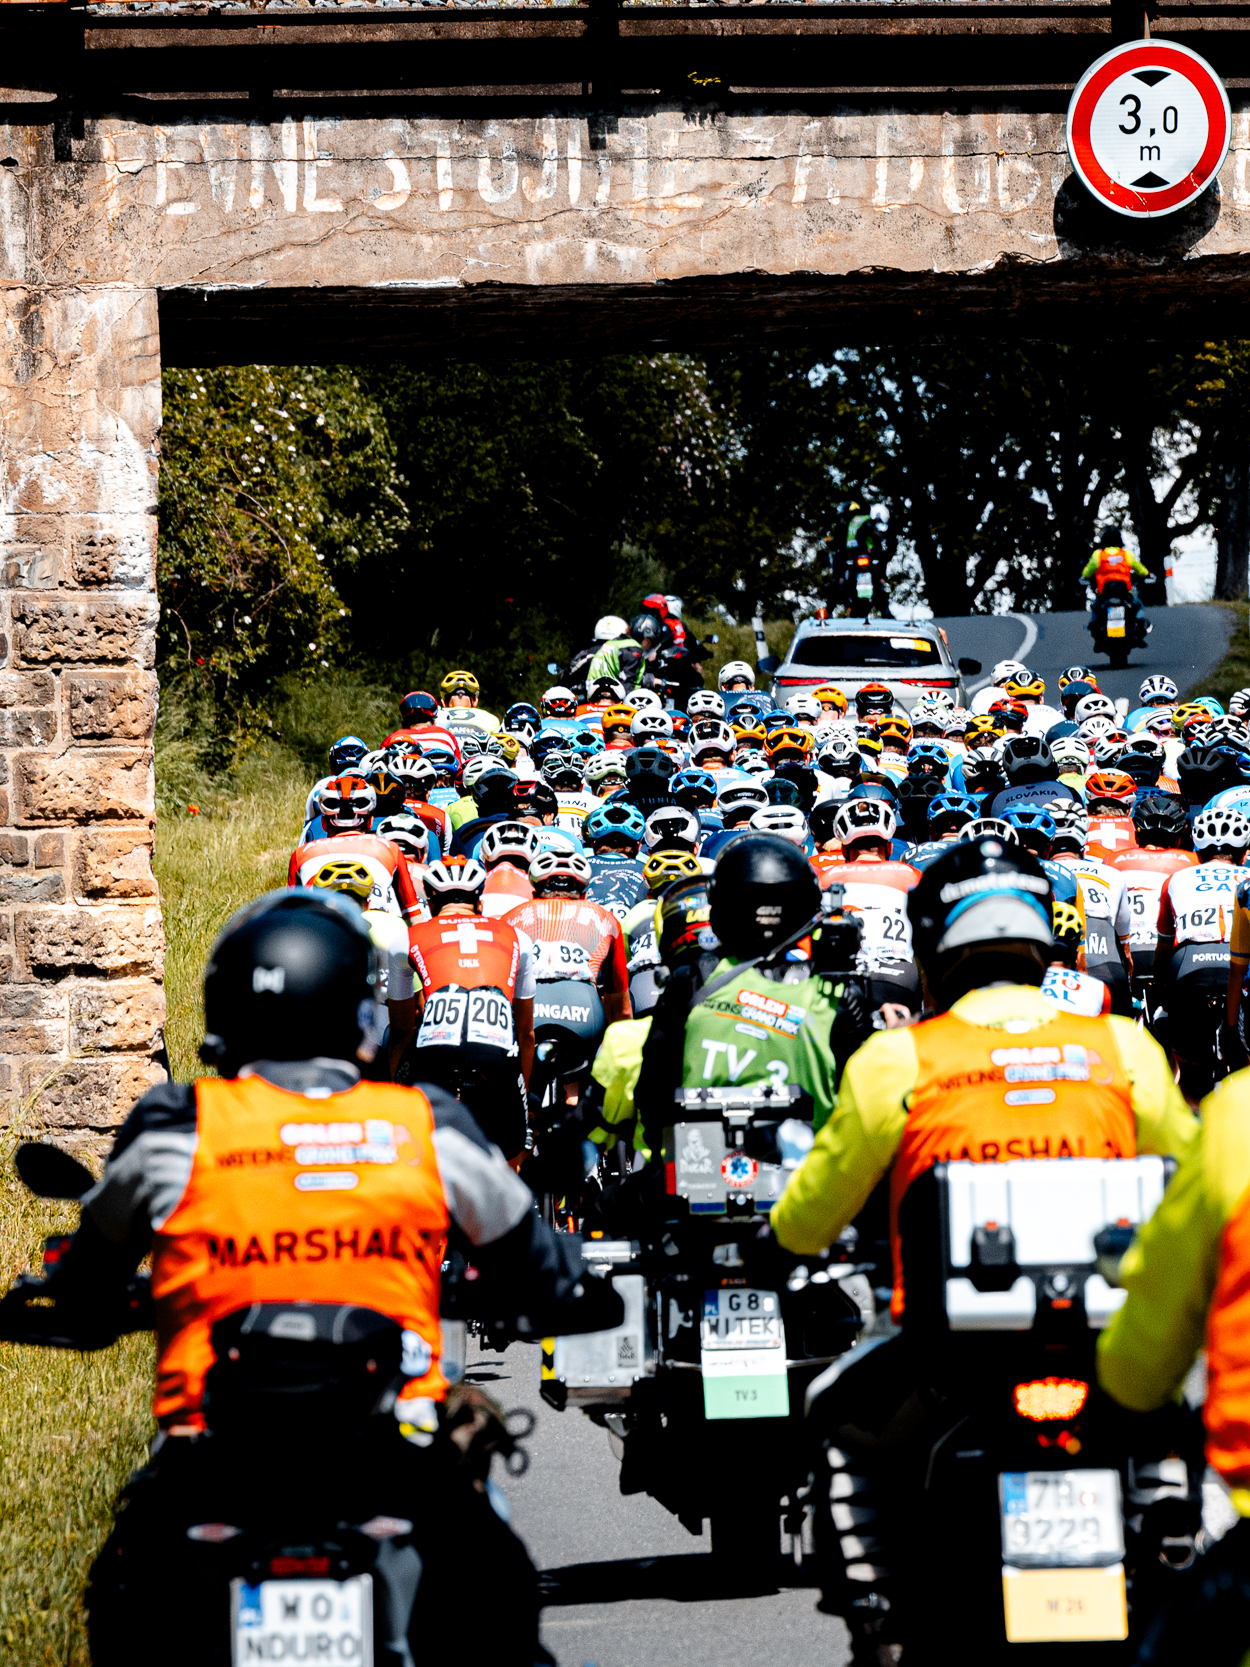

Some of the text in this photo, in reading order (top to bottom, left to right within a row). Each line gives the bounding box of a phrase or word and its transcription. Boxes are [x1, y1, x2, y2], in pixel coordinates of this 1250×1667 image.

[1118, 94, 1179, 138] 3,0
[1139, 145, 1161, 161] m
[1005, 790, 1059, 804] SLOVAKIA
[1115, 853, 1191, 864] AUSTRIA
[828, 863, 914, 876] AUSTRIA
[1195, 882, 1235, 893] GA
[883, 915, 907, 943] 22
[1179, 907, 1217, 930] 162
[560, 945, 584, 964] 93
[423, 997, 508, 1030] 205 205
[533, 1003, 590, 1023] UNGARY
[738, 990, 787, 1016] ORLEN
[701, 1039, 757, 1082] TV
[208, 1227, 408, 1268] MARSHAL
